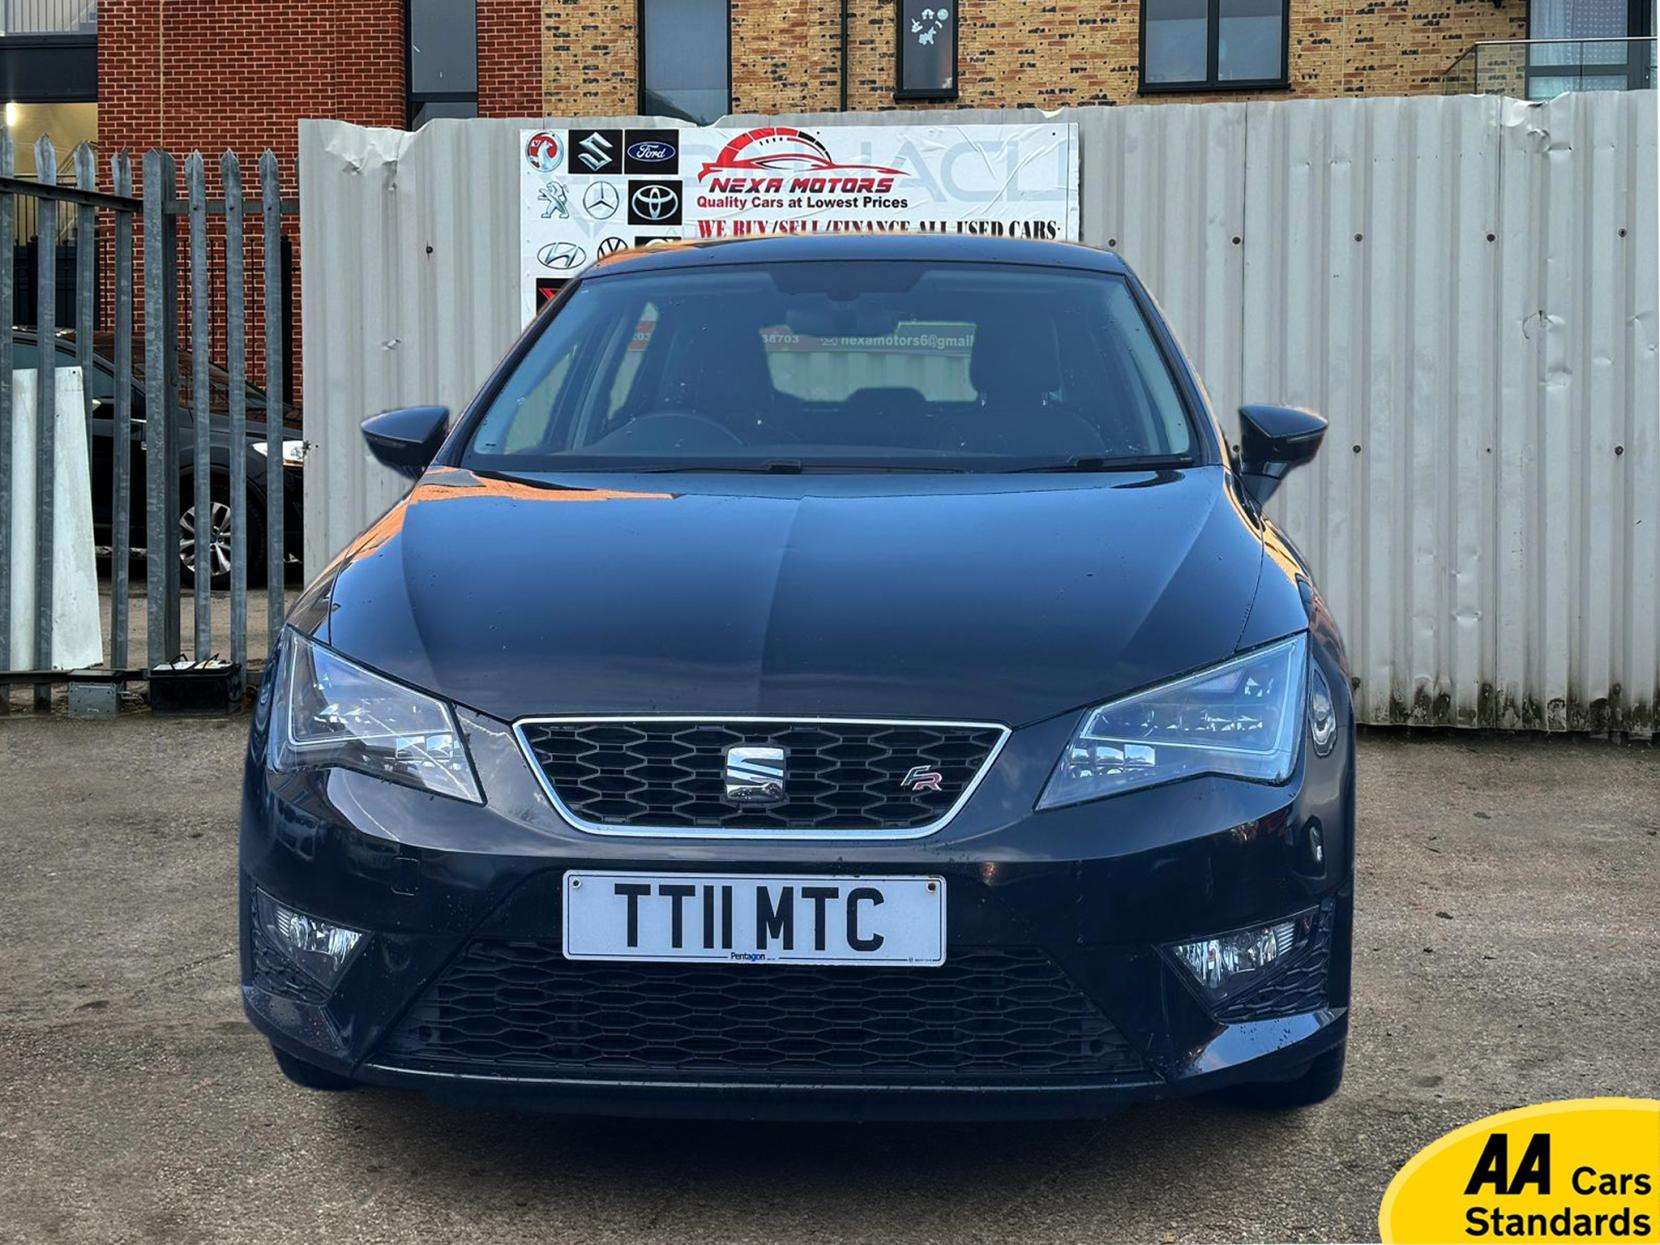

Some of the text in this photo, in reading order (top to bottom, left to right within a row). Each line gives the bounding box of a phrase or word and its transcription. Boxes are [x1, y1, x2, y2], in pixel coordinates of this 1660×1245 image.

[636, 144, 666, 159] Ford
[708, 177, 895, 194] NEXA MOTORS
[696, 196, 909, 211] Quality Cars at Lowest Prices
[697, 219, 727, 239] WE
[956, 220, 1004, 238] USED
[901, 764, 943, 791] FR
[756, 885, 885, 953] MTC
[730, 951, 766, 962] Pentagon
